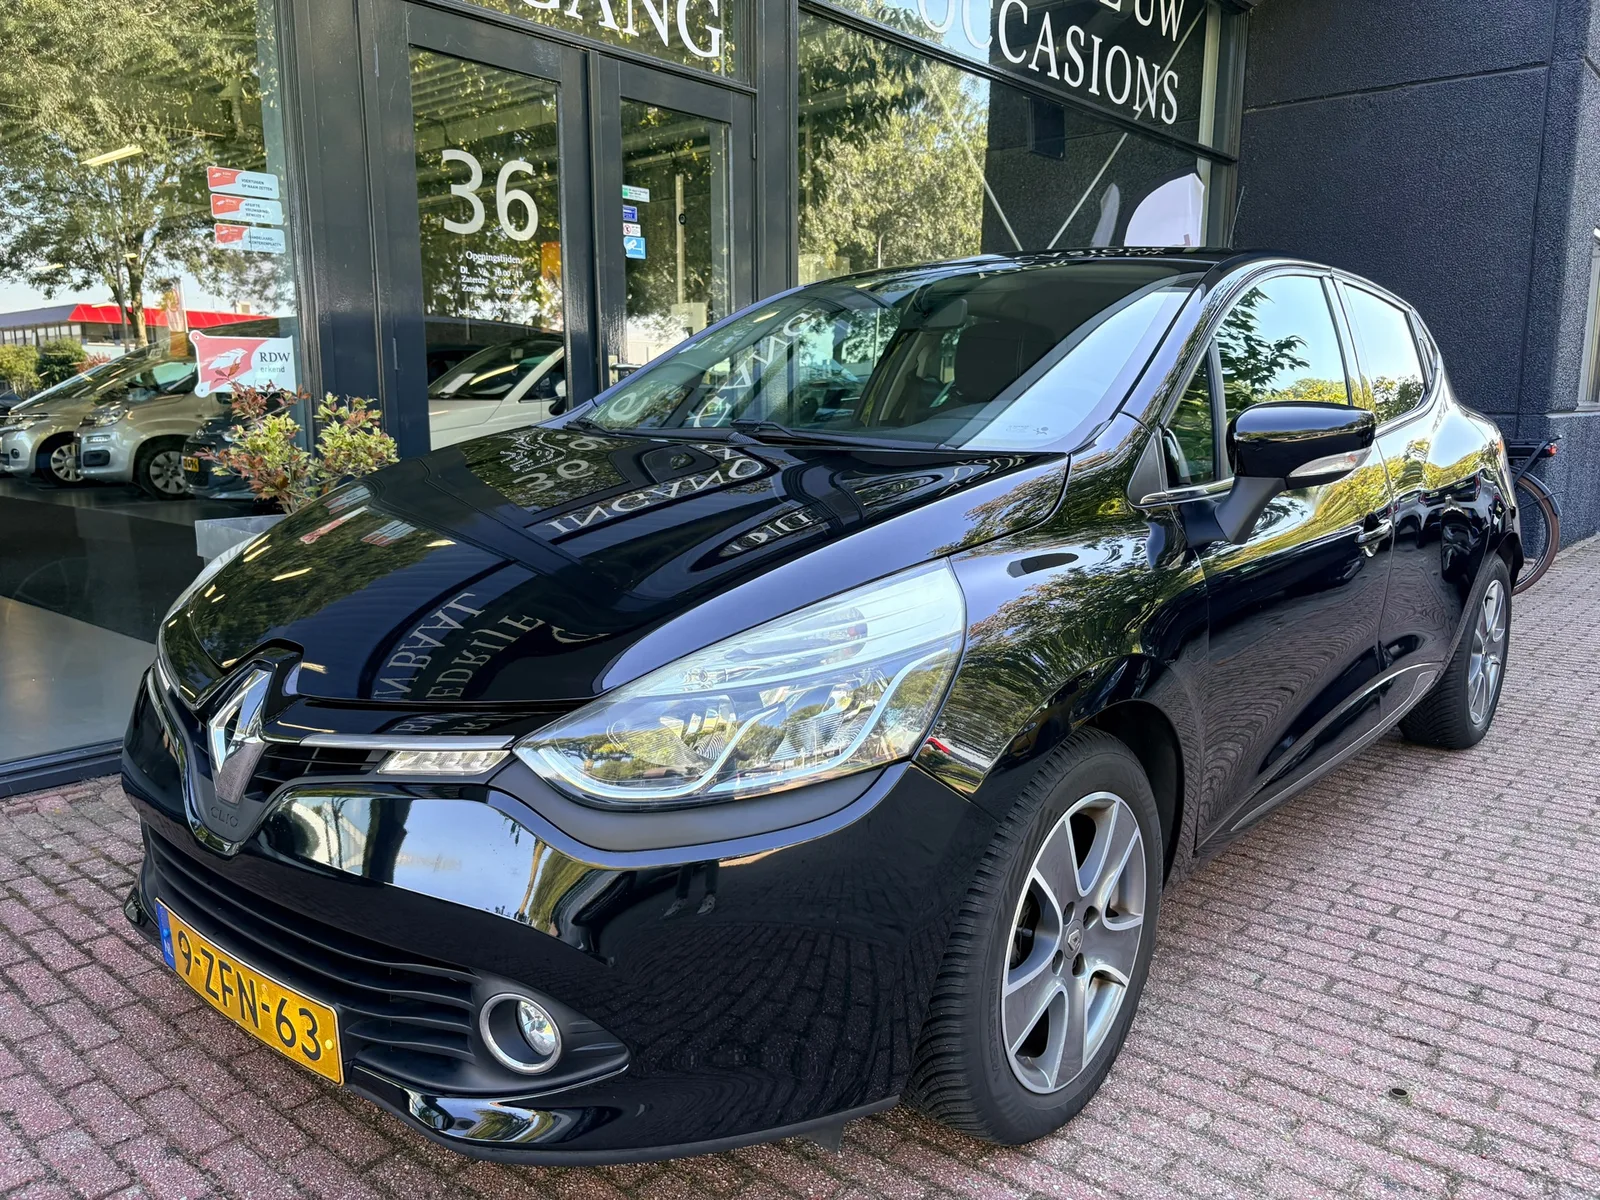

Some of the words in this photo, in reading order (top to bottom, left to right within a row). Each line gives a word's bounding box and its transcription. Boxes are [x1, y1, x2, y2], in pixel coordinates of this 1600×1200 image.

[917, 0, 1179, 124] OCCASIONS
[442, 149, 538, 241] 36
[259, 352, 290, 362] RDW
[210, 806, 239, 828] CLIO
[178, 929, 321, 1062] 9-ZFN-63
